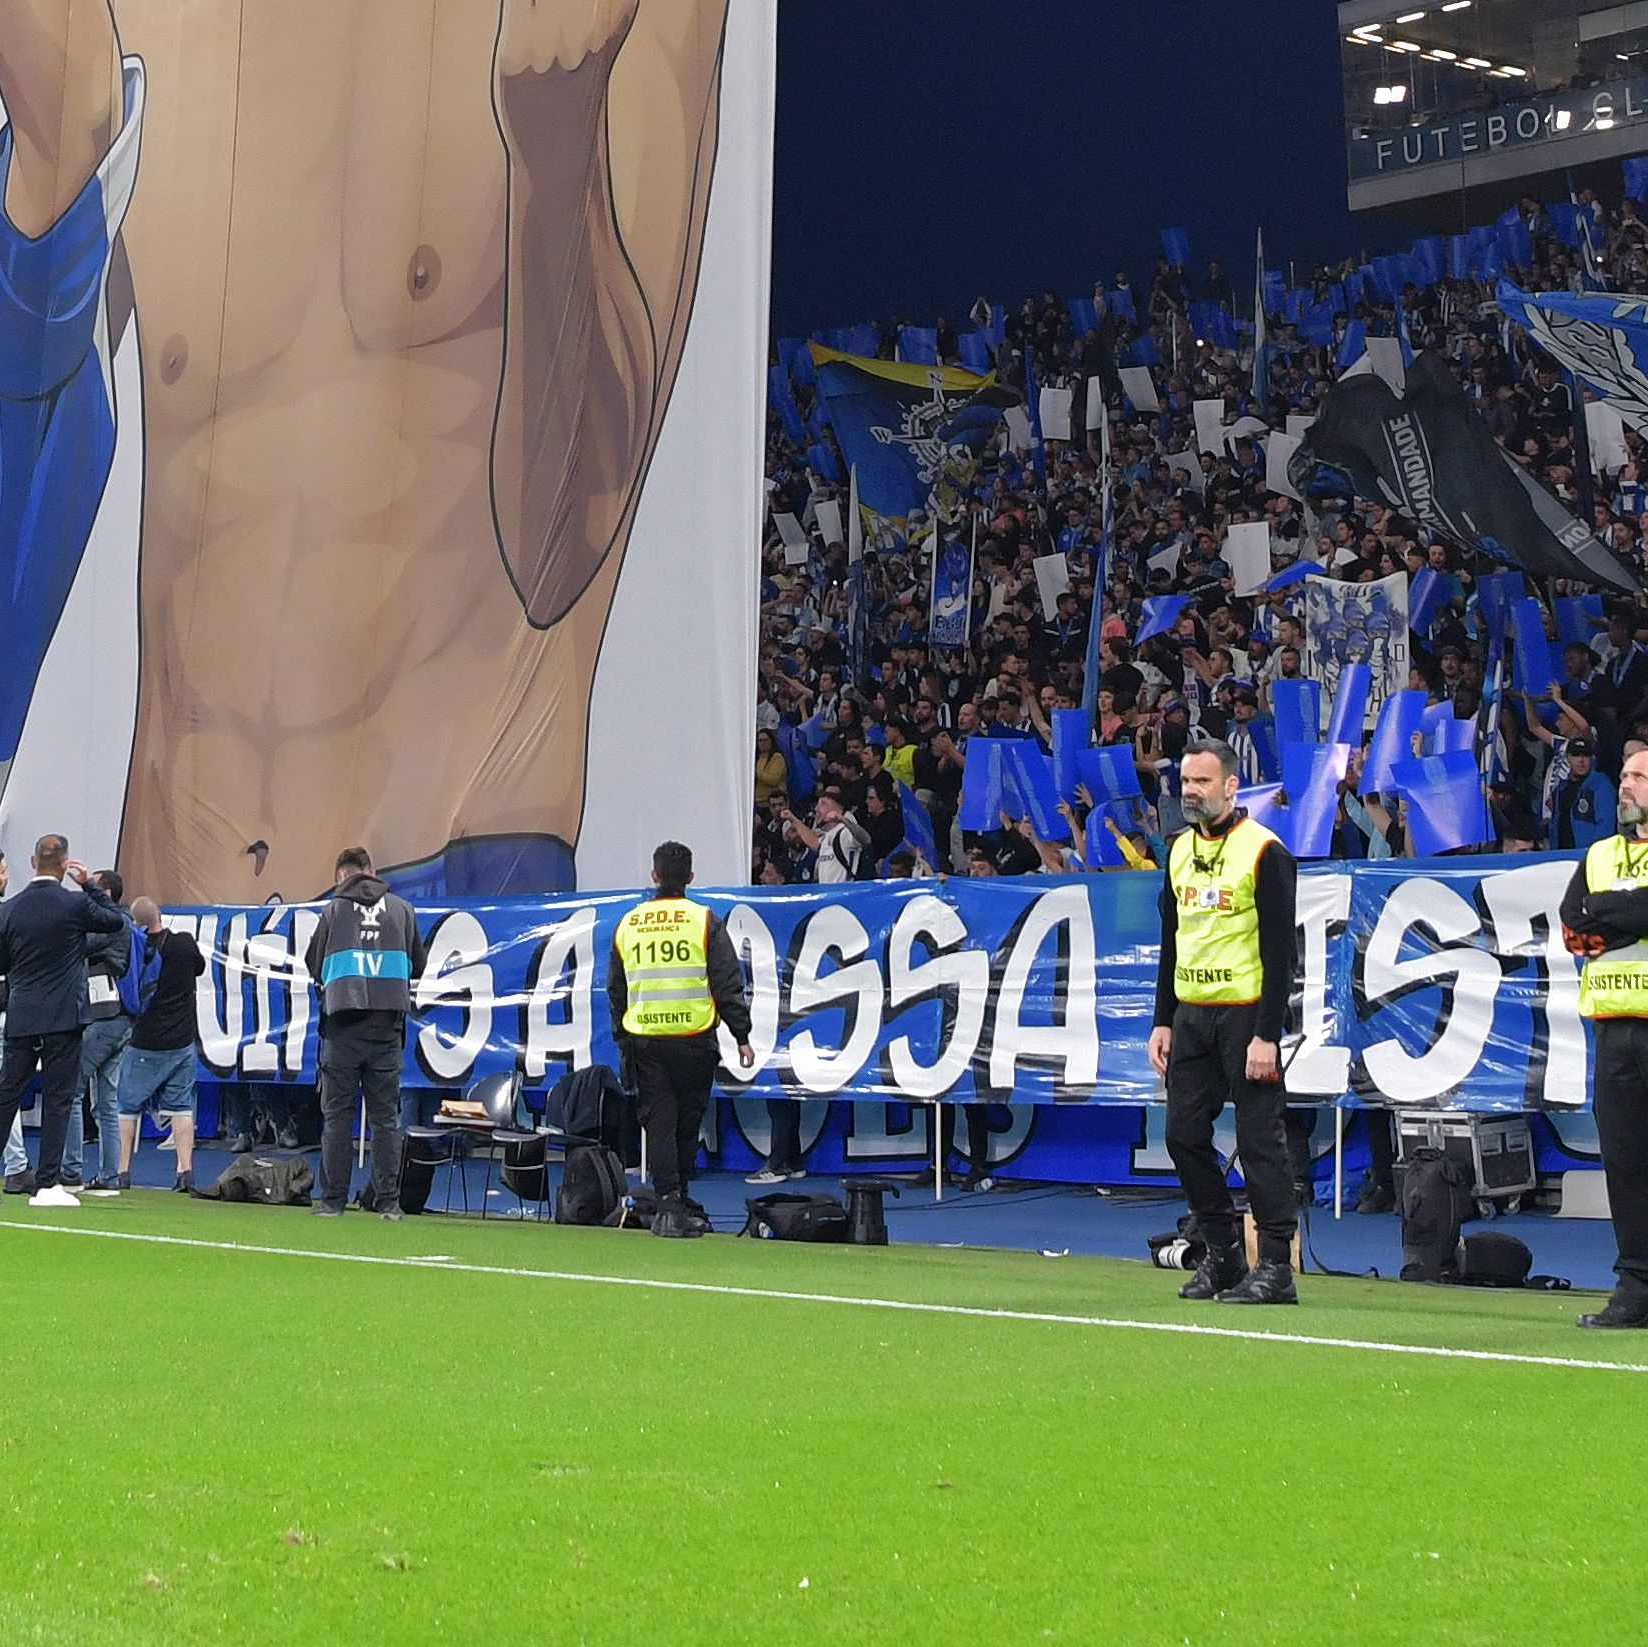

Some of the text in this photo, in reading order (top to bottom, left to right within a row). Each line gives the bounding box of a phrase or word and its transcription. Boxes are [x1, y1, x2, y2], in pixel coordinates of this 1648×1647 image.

[1376, 104, 1560, 170] FUTEBOL
[629, 909, 691, 926] S.P.D.E.
[631, 939, 691, 964] 1196
[353, 952, 384, 977] TV
[718, 884, 1099, 1098] OSSA
